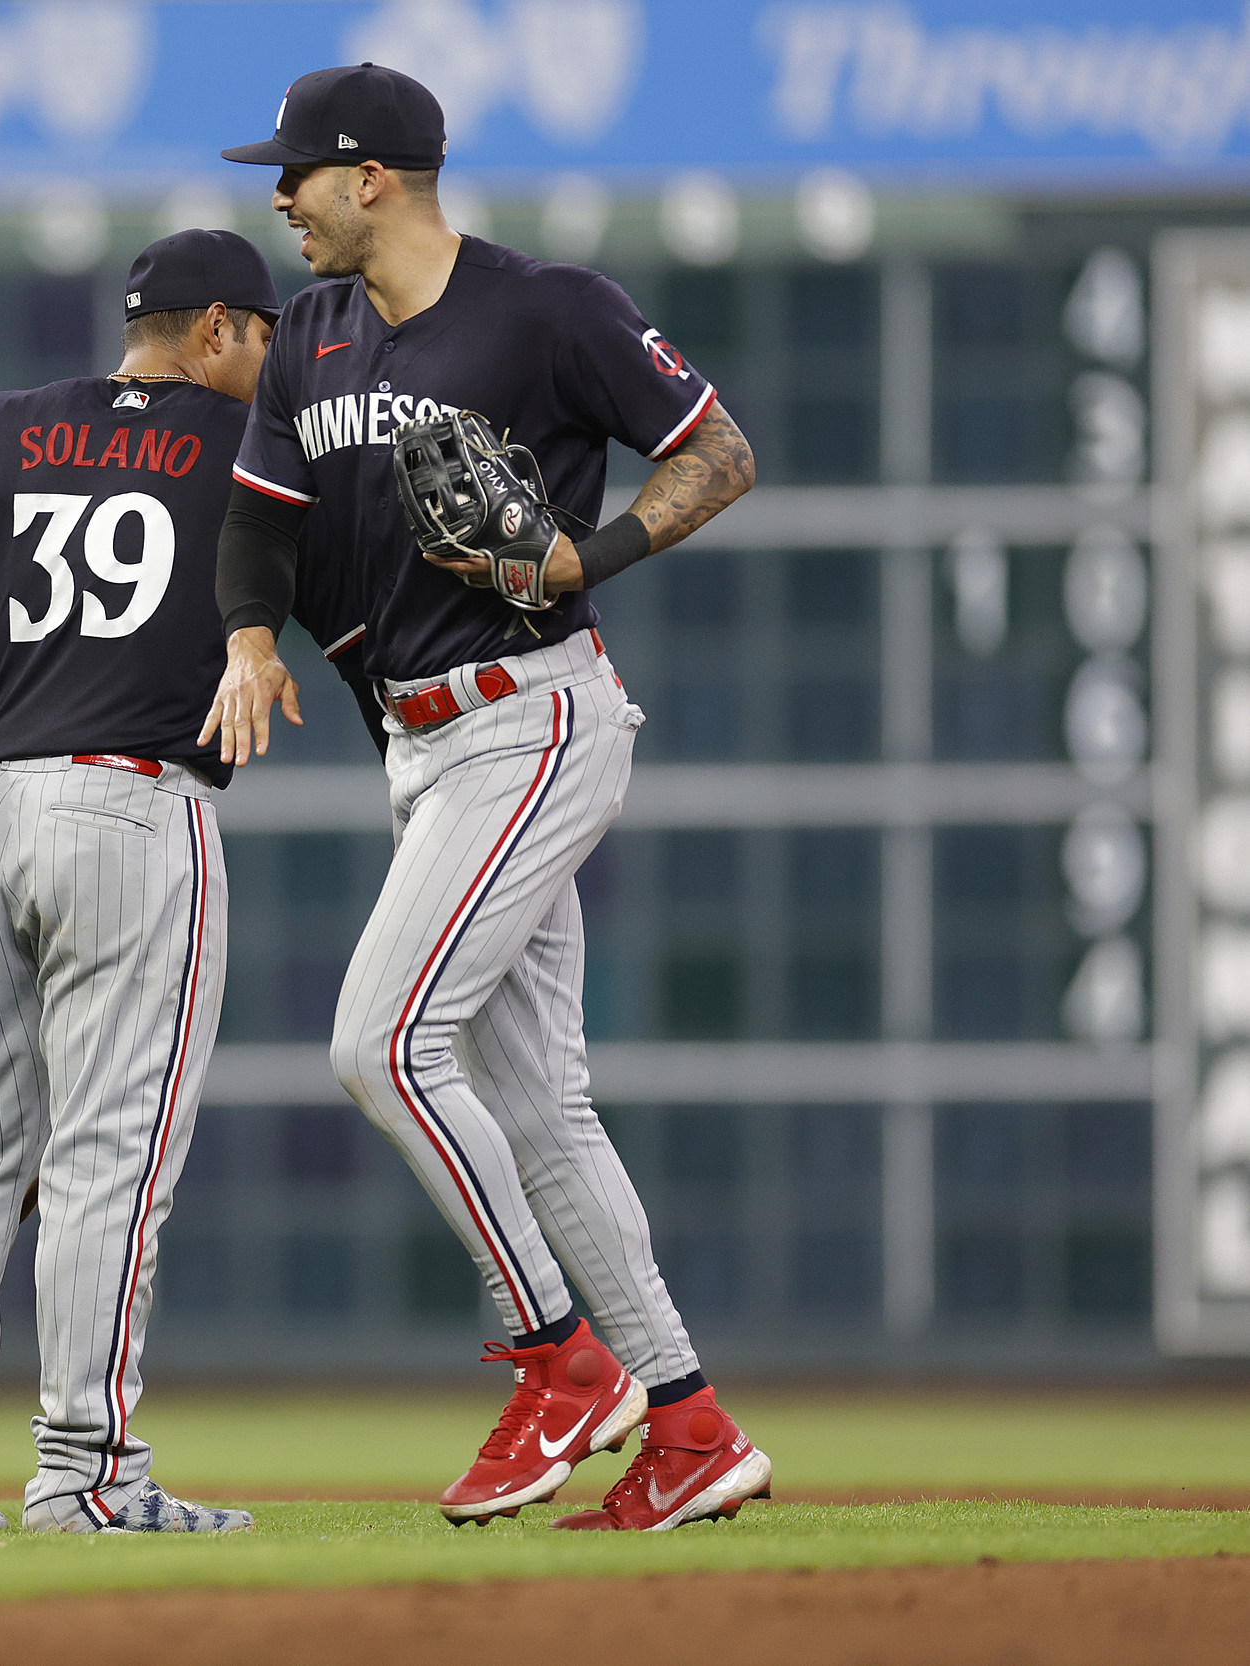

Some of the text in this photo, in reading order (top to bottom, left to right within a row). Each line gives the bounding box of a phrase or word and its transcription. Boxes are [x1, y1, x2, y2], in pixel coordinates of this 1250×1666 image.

[20, 422, 202, 478] SOLANO
[478, 460, 509, 495] KYLO
[9, 492, 176, 643] 39
